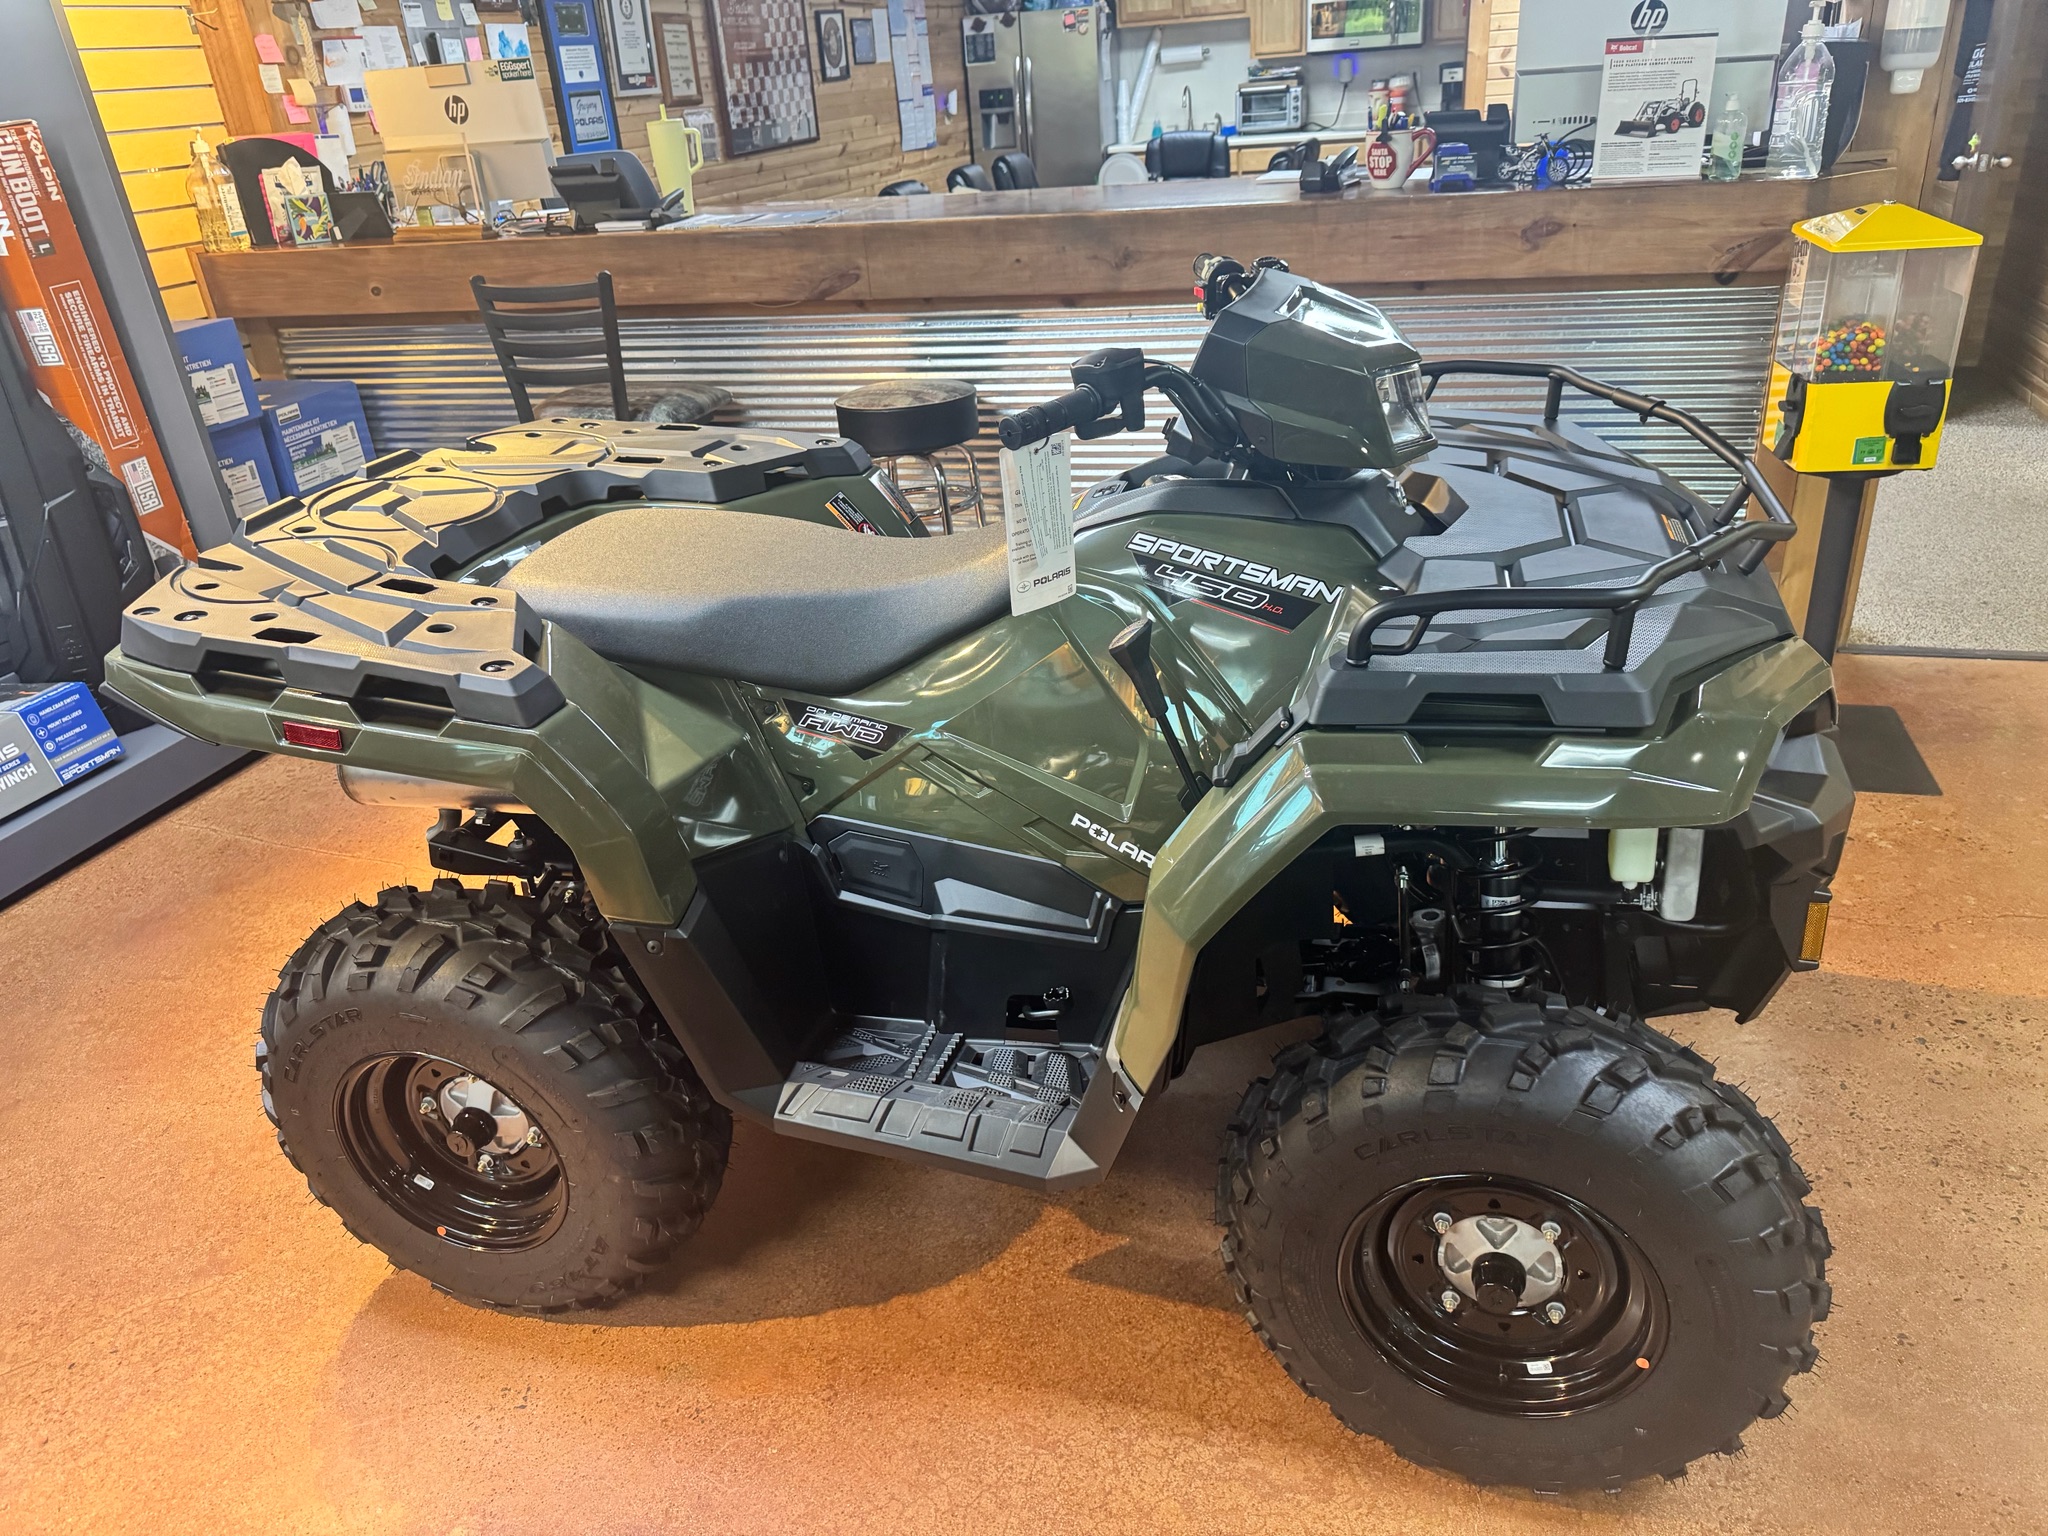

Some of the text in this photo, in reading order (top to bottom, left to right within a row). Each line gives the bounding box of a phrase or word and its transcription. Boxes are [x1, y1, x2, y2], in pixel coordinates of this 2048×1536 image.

[1634, 0, 1666, 36] hp
[1620, 44, 1638, 52] Bobcat
[500, 60, 530, 72] EGGspert
[502, 70, 519, 80] spoken
[448, 95, 466, 125] hp
[575, 116, 604, 126] POLARIS
[24, 127, 62, 202] KOLPIN
[1369, 156, 1392, 168] STOP
[1372, 148, 1388, 156] SANTA
[9, 177, 50, 237] BOOT
[39, 244, 50, 254] L
[38, 311, 50, 332] MADE
[33, 336, 61, 362] USA
[64, 292, 125, 438] SECURE FIREARMS IN TRANSIT
[72, 290, 132, 436] ENGINEERED TO PROTECT AND
[282, 421, 312, 436] MAINTENANCE
[136, 480, 160, 511] USA
[1033, 566, 1071, 588] POLARIS
[1127, 532, 1344, 604] SPORTSMAN
[1154, 564, 1283, 615] 450 H.O.
[39, 700, 64, 716] HANDLEBAR
[63, 694, 80, 706] SWITCH
[48, 718, 62, 730] MOUNT
[62, 710, 82, 724] INCLUDED
[798, 712, 884, 744] AWD
[806, 706, 888, 731] ON DEMAND
[55, 724, 88, 742] PREASSEMBLED
[2, 758, 21, 772] SERIES
[62, 746, 122, 780] SPORTSMAN
[284, 1007, 362, 1084] CARLSTAR
